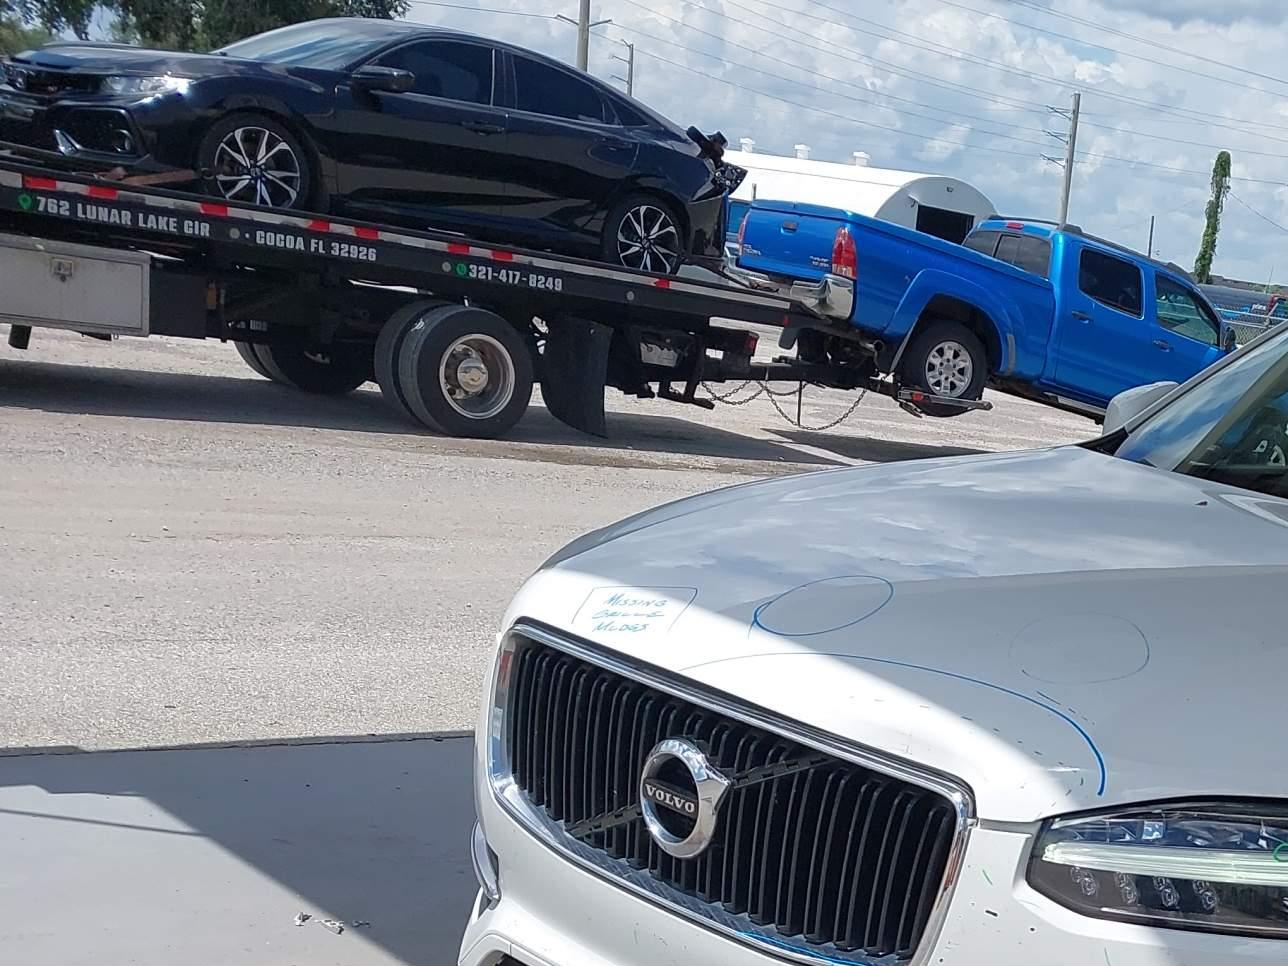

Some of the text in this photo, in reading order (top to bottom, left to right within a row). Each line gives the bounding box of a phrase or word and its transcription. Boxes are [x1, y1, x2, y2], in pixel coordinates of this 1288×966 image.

[36, 196, 210, 237] 762 LUNAR LAKE CIR
[256, 230, 377, 261] COCOA FL 32926
[469, 264, 562, 291] 321-417-8249
[645, 783, 696, 813] VOLVO
